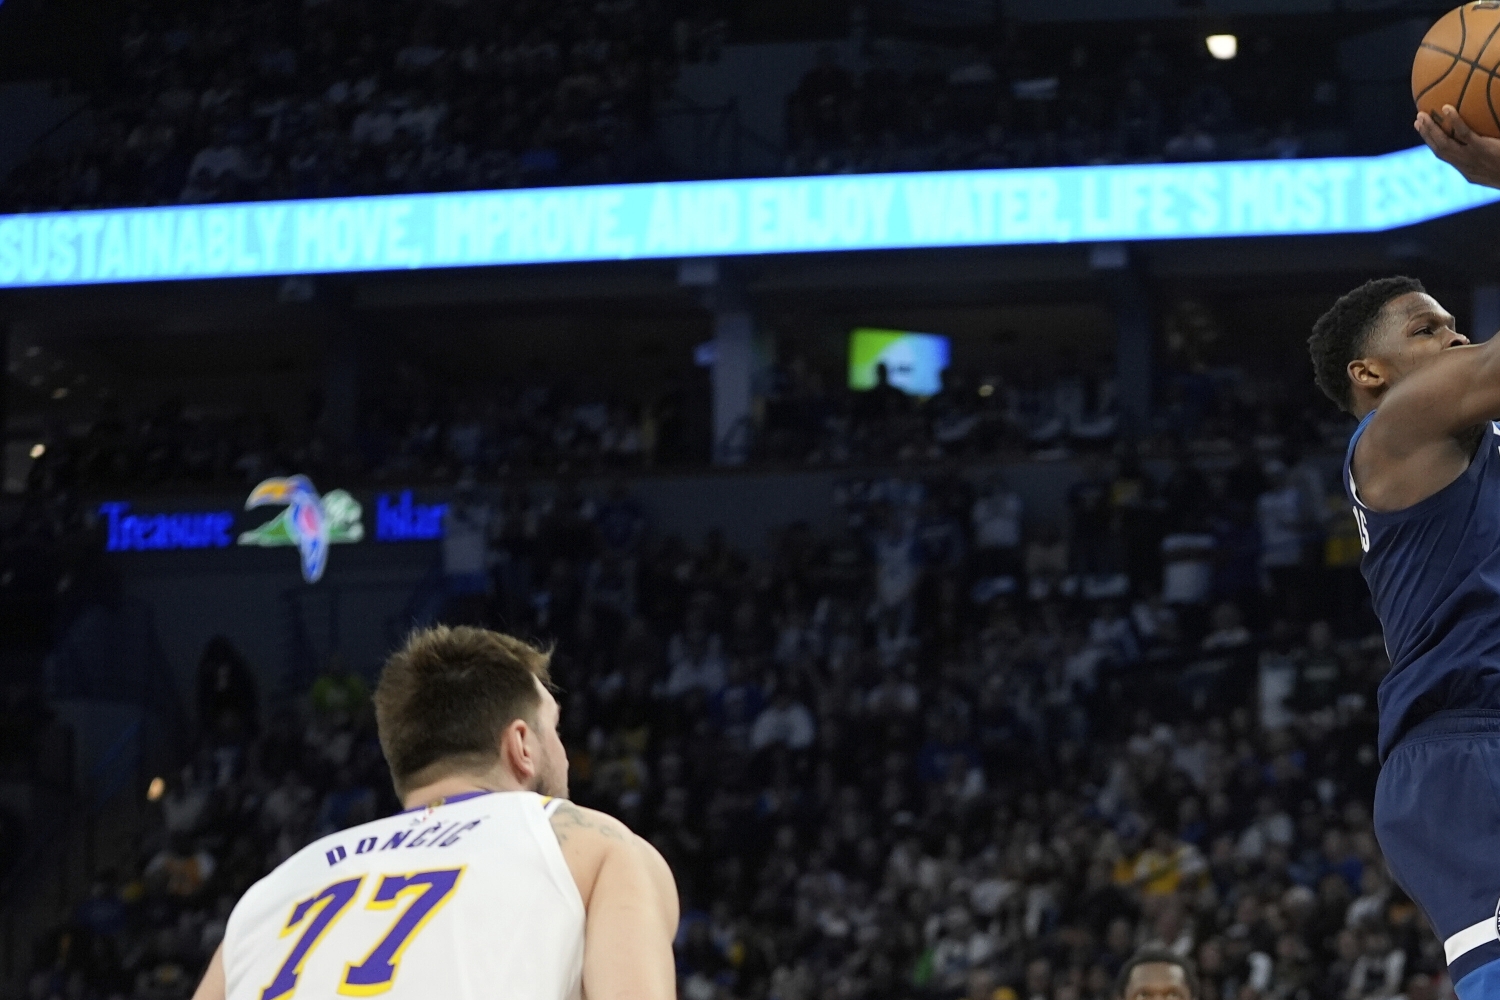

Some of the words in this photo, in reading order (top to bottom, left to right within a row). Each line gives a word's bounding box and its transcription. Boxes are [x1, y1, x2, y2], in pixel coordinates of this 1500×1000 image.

[0, 207, 284, 280] SUSTAINABLY
[297, 204, 423, 268] MOVE,
[435, 193, 635, 260] IMPROVE,
[645, 186, 741, 252] AND
[747, 180, 898, 249] ENJOY
[904, 175, 1072, 242] WATER,
[1082, 168, 1219, 235] LIFE'S
[1229, 164, 1351, 231] MOST
[100, 501, 233, 549] Treasure
